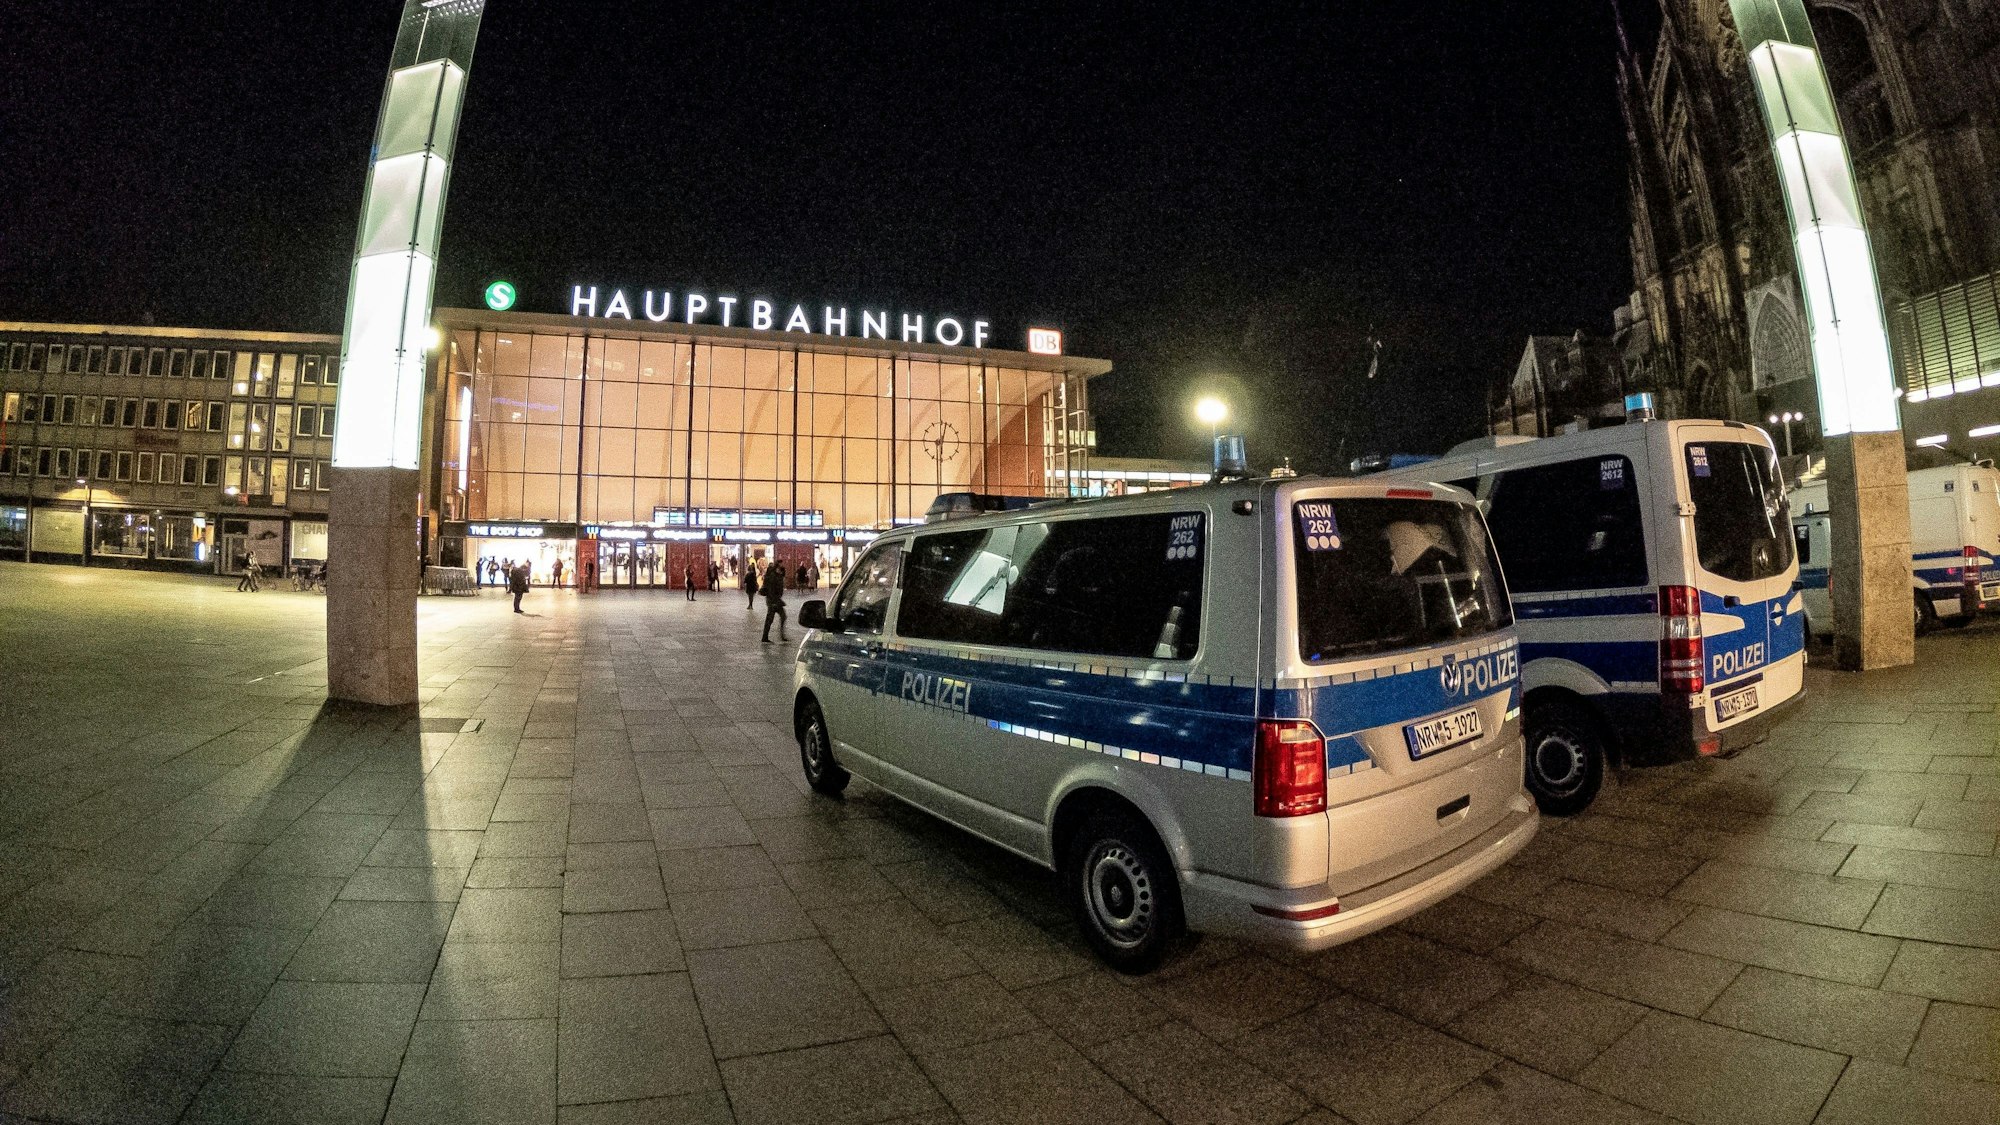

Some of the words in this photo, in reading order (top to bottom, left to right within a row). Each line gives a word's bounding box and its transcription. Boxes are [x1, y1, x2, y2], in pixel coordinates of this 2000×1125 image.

[489, 284, 510, 308] S
[572, 285, 990, 348] HAUPTBAHNHOF
[1034, 333, 1057, 351] DB
[1689, 447, 1706, 456] NRW
[1601, 459, 1623, 470] NRW
[1602, 469, 1623, 481] 2612
[1299, 504, 1332, 518] NRW
[1171, 514, 1200, 530] NRW
[1309, 520, 1333, 534] 262
[470, 526, 489, 536] THE
[490, 527, 517, 536] BODY
[517, 527, 544, 537] SHOP
[1173, 530, 1195, 545] 262
[1713, 642, 1764, 678] POLIZEI
[1463, 650, 1518, 696] POLIZEI
[902, 672, 972, 713] POLIZEI
